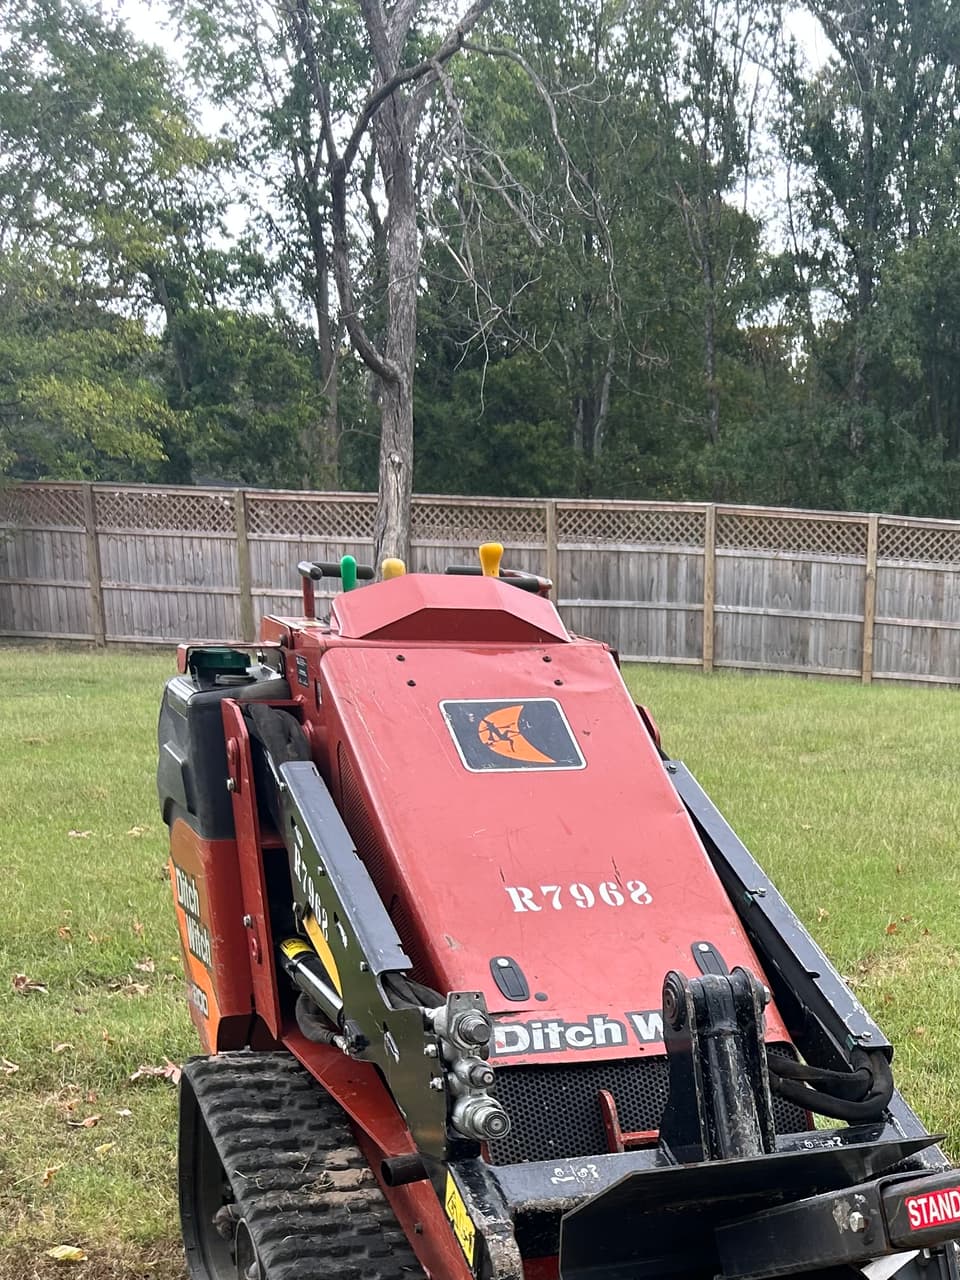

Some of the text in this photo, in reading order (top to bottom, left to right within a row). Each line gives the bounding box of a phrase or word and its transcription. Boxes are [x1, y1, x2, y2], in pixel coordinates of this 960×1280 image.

[175, 866, 200, 918] Ditch
[505, 880, 653, 912] R7968
[185, 912, 213, 968] Witch
[494, 1017, 623, 1054] Ditch
